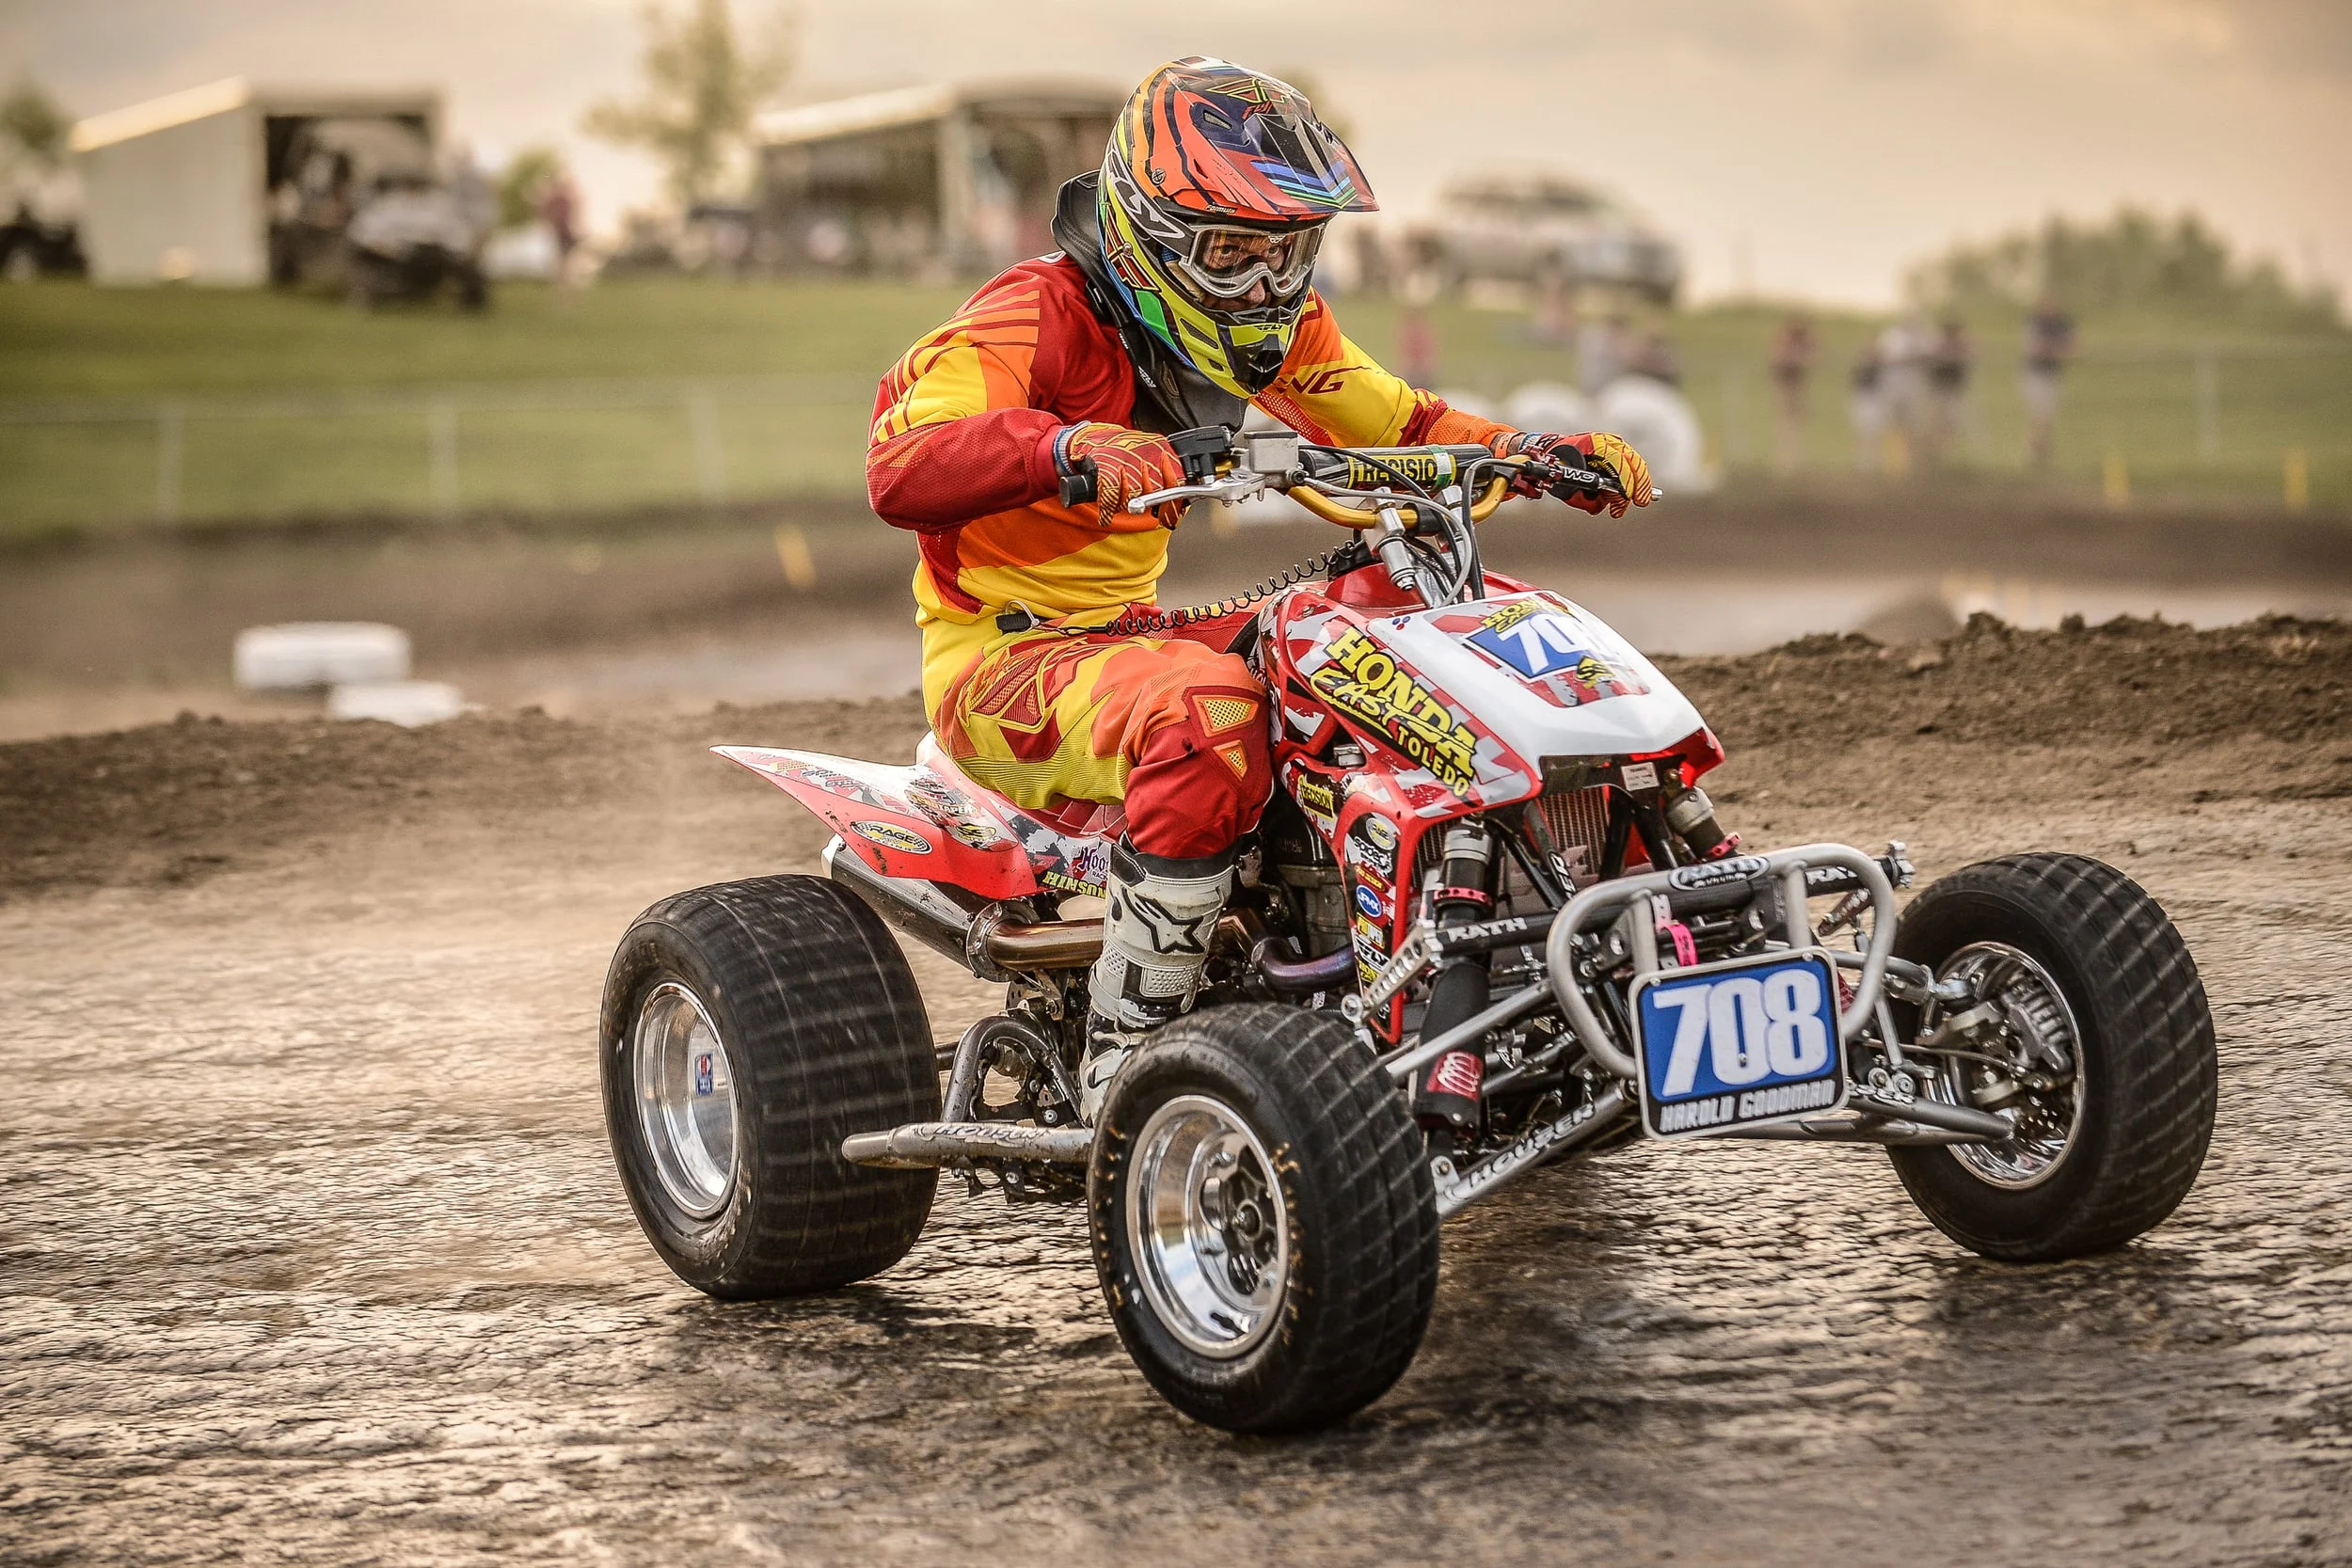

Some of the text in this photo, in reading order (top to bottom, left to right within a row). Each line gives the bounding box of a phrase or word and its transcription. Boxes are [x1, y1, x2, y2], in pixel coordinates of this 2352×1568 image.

[1353, 456, 1438, 483] RECISIO
[1325, 626, 1479, 779] HONDA
[1398, 726, 1470, 797] TOLEDO
[870, 825, 915, 843] RAGE
[1077, 847, 1107, 872] Hoo
[1042, 871, 1106, 898] HINSON
[1805, 866, 1858, 885] RA
[1447, 917, 1528, 942] RATH
[1653, 969, 1828, 1097] 708
[1660, 1096, 1736, 1132] HAROLD
[1470, 1102, 1595, 1188] HOUSER
